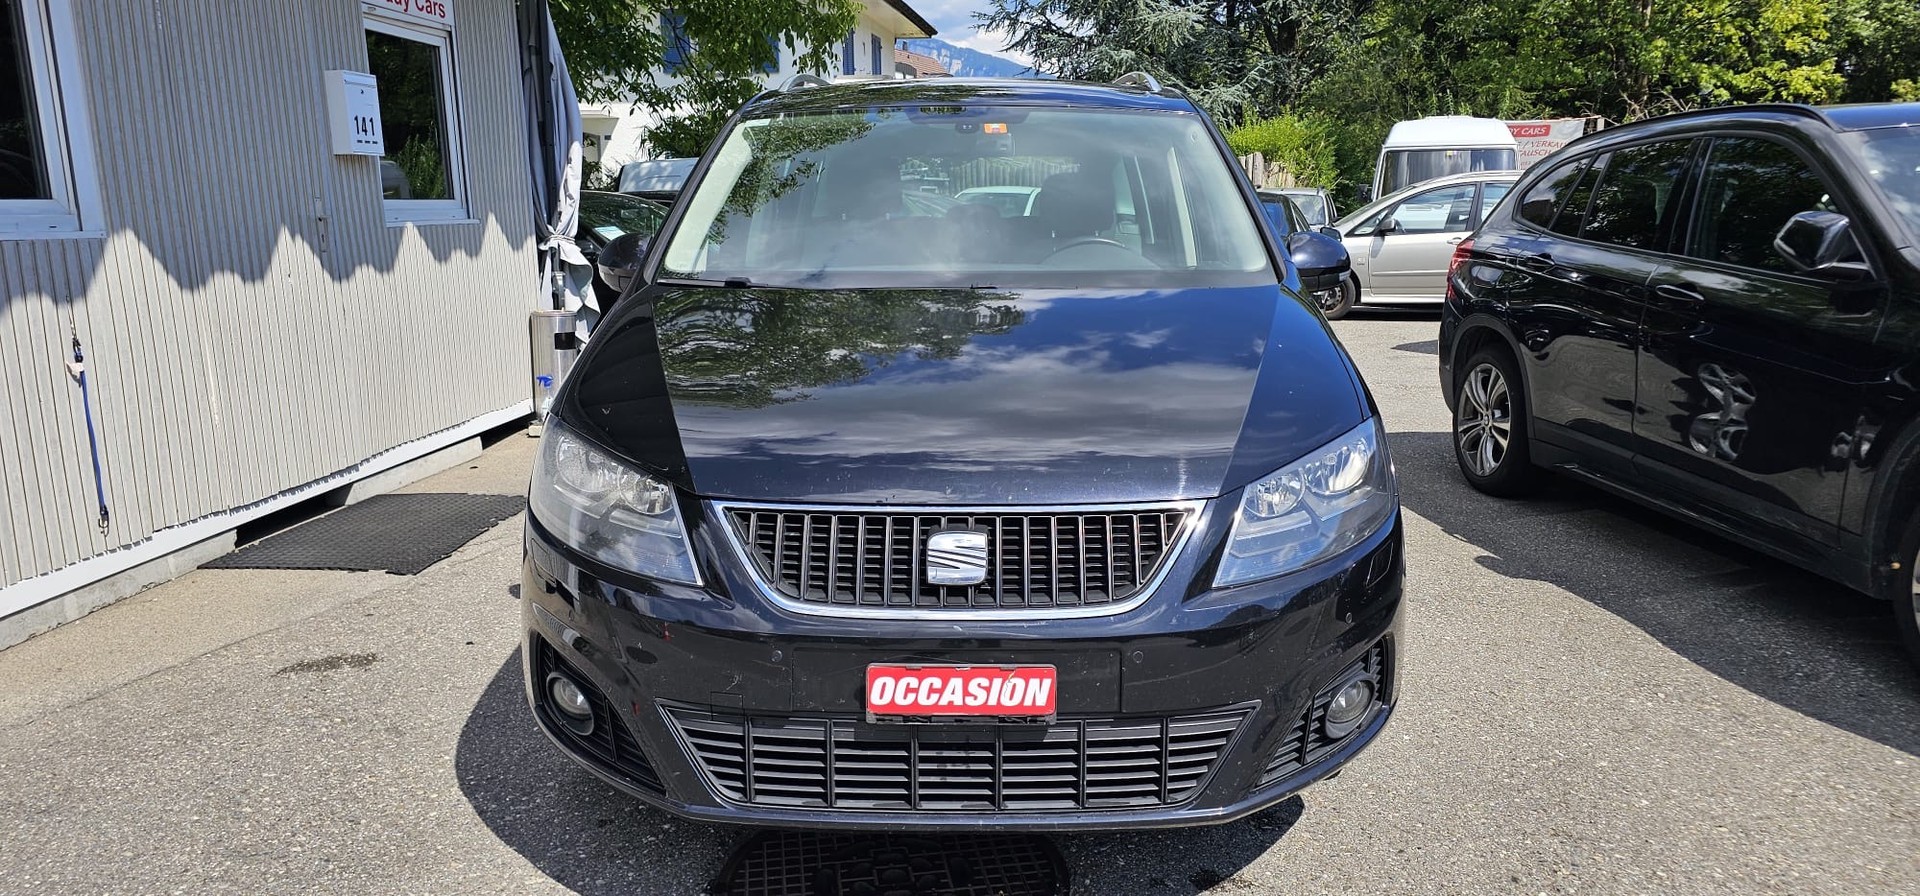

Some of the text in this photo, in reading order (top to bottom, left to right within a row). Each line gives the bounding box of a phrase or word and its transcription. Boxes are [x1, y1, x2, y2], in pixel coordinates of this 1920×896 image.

[415, 0, 446, 19] Cars
[354, 115, 375, 136] 141
[1521, 127, 1546, 135] CARS
[870, 676, 1052, 707] OCCASION
